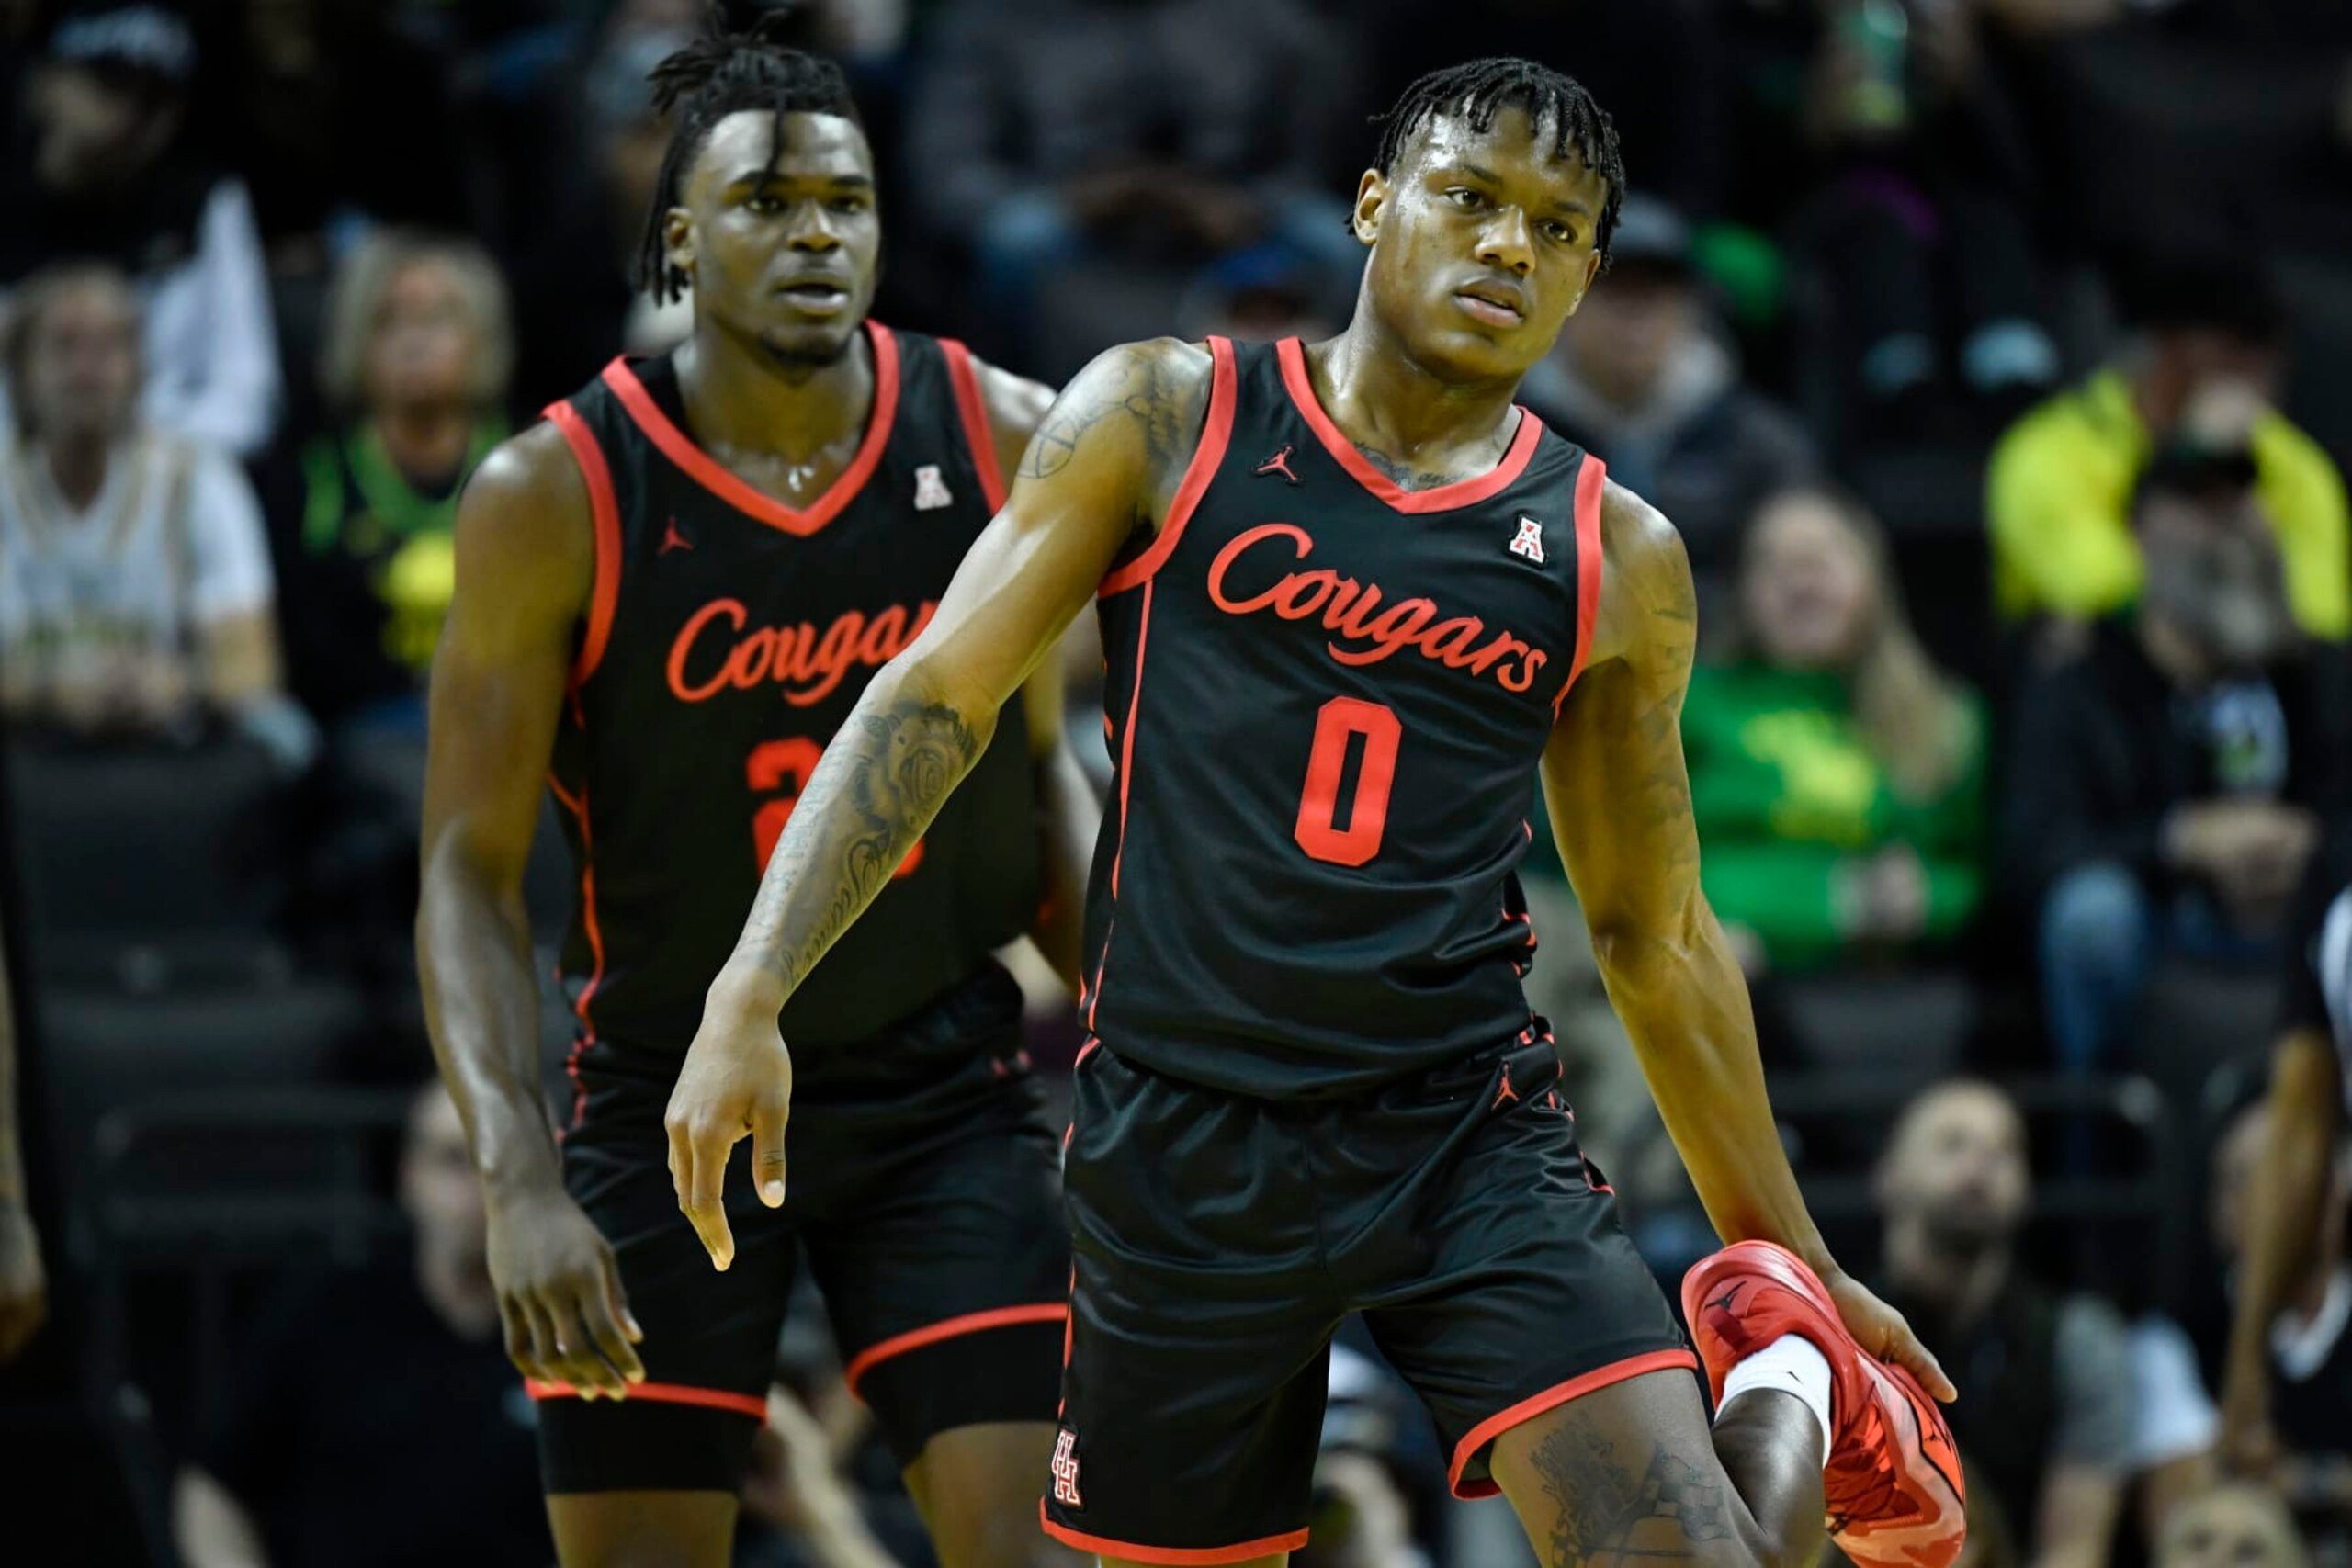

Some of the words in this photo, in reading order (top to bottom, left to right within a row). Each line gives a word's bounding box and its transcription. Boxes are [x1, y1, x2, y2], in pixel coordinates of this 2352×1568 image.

[1207, 523, 1548, 693] Cougars
[1509, 516, 1545, 564] A
[1294, 695, 1403, 868] 0
